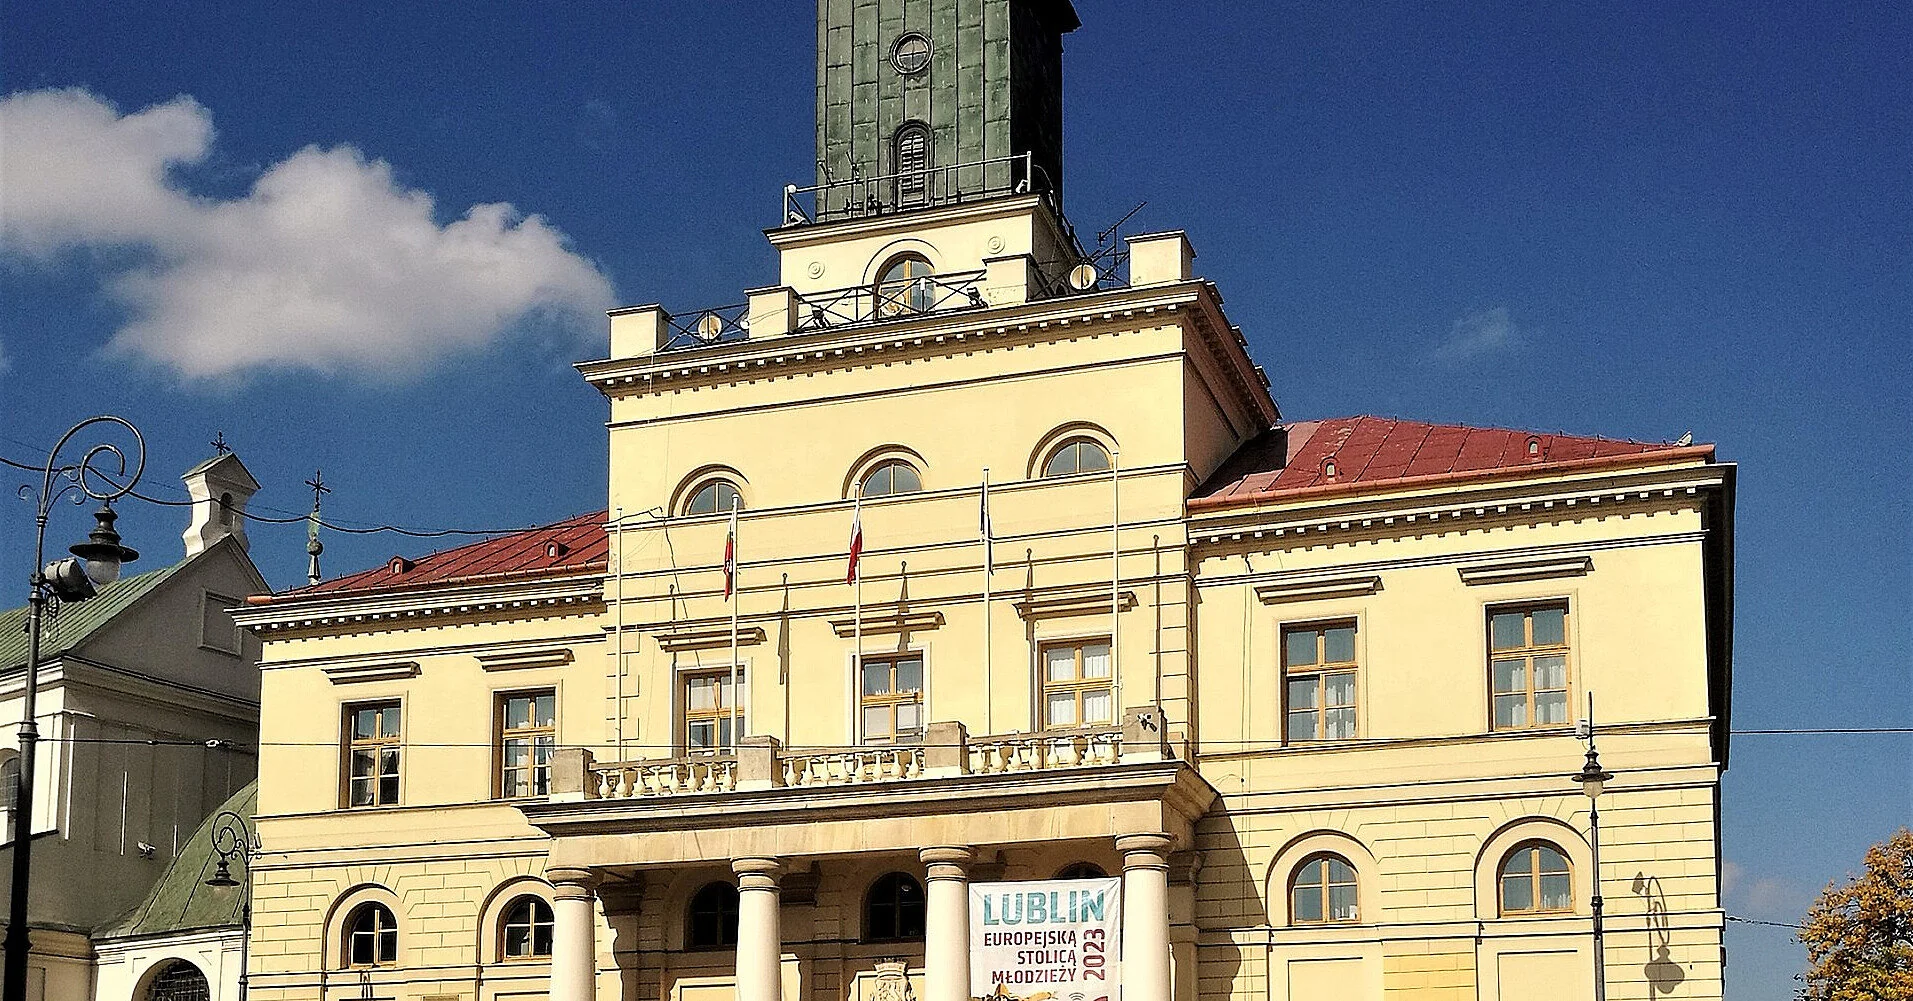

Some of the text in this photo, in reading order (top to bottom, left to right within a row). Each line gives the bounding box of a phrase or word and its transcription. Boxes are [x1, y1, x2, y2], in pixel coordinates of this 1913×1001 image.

[984, 890, 1105, 925] LUBLIN
[984, 930, 1077, 948] EUROPEJSKĄ
[1017, 949, 1077, 967] STOLICĄ
[1083, 928, 1106, 981] 2023
[992, 965, 1077, 985] MŁODZIEŻY
